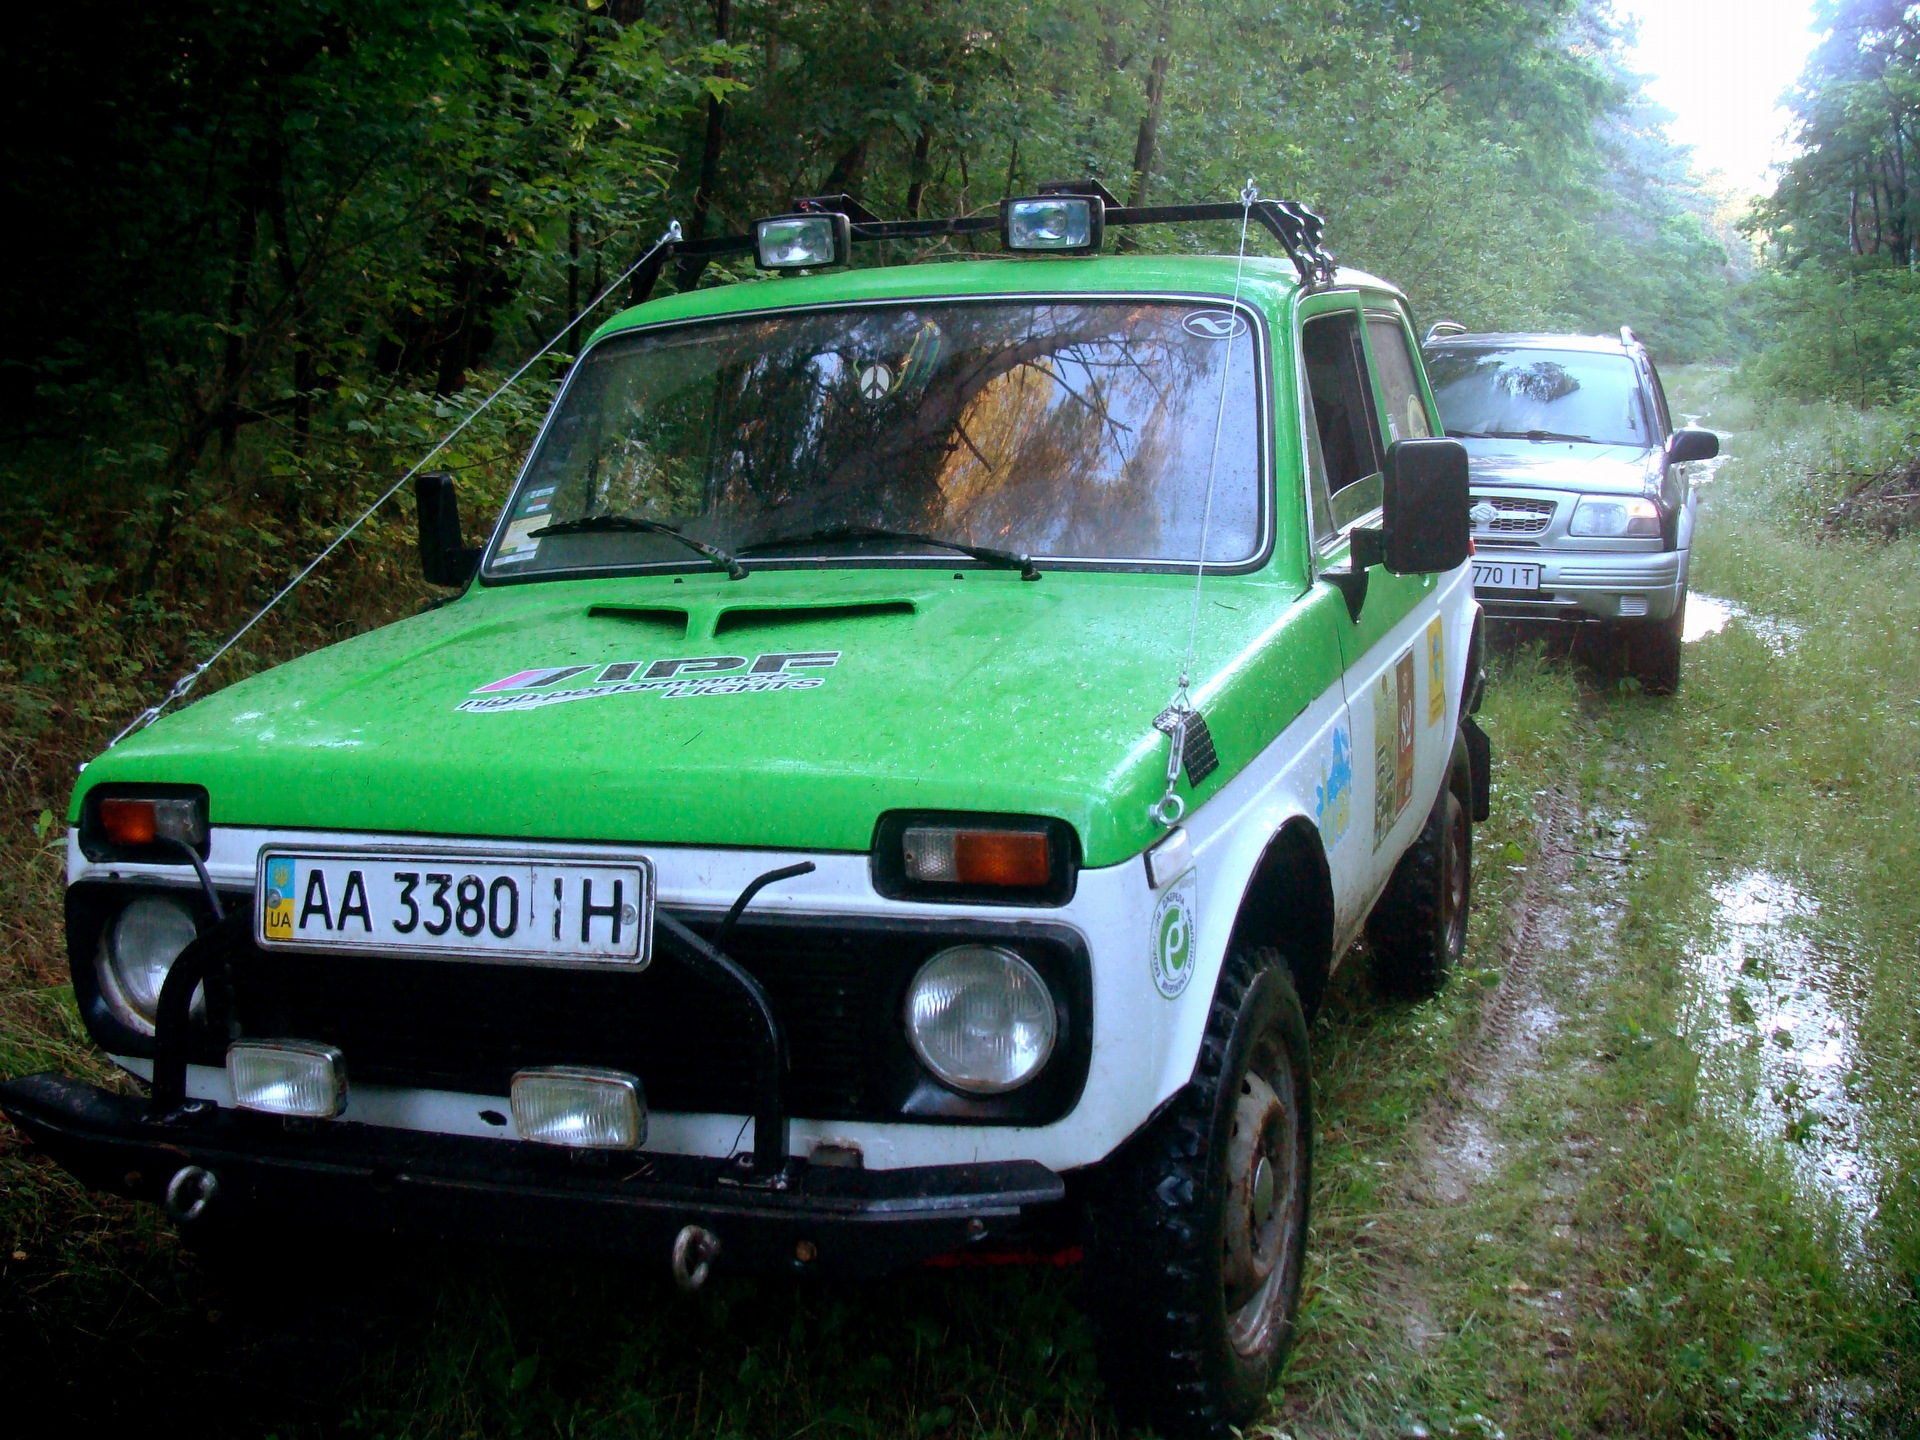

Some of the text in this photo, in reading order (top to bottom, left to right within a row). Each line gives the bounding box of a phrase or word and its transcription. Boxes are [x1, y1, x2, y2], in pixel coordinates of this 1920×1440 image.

[596, 652, 841, 681] IPF
[664, 679, 824, 698] LIGHTS
[299, 869, 623, 944] AA 3380 IH
[270, 911, 291, 928] UA
